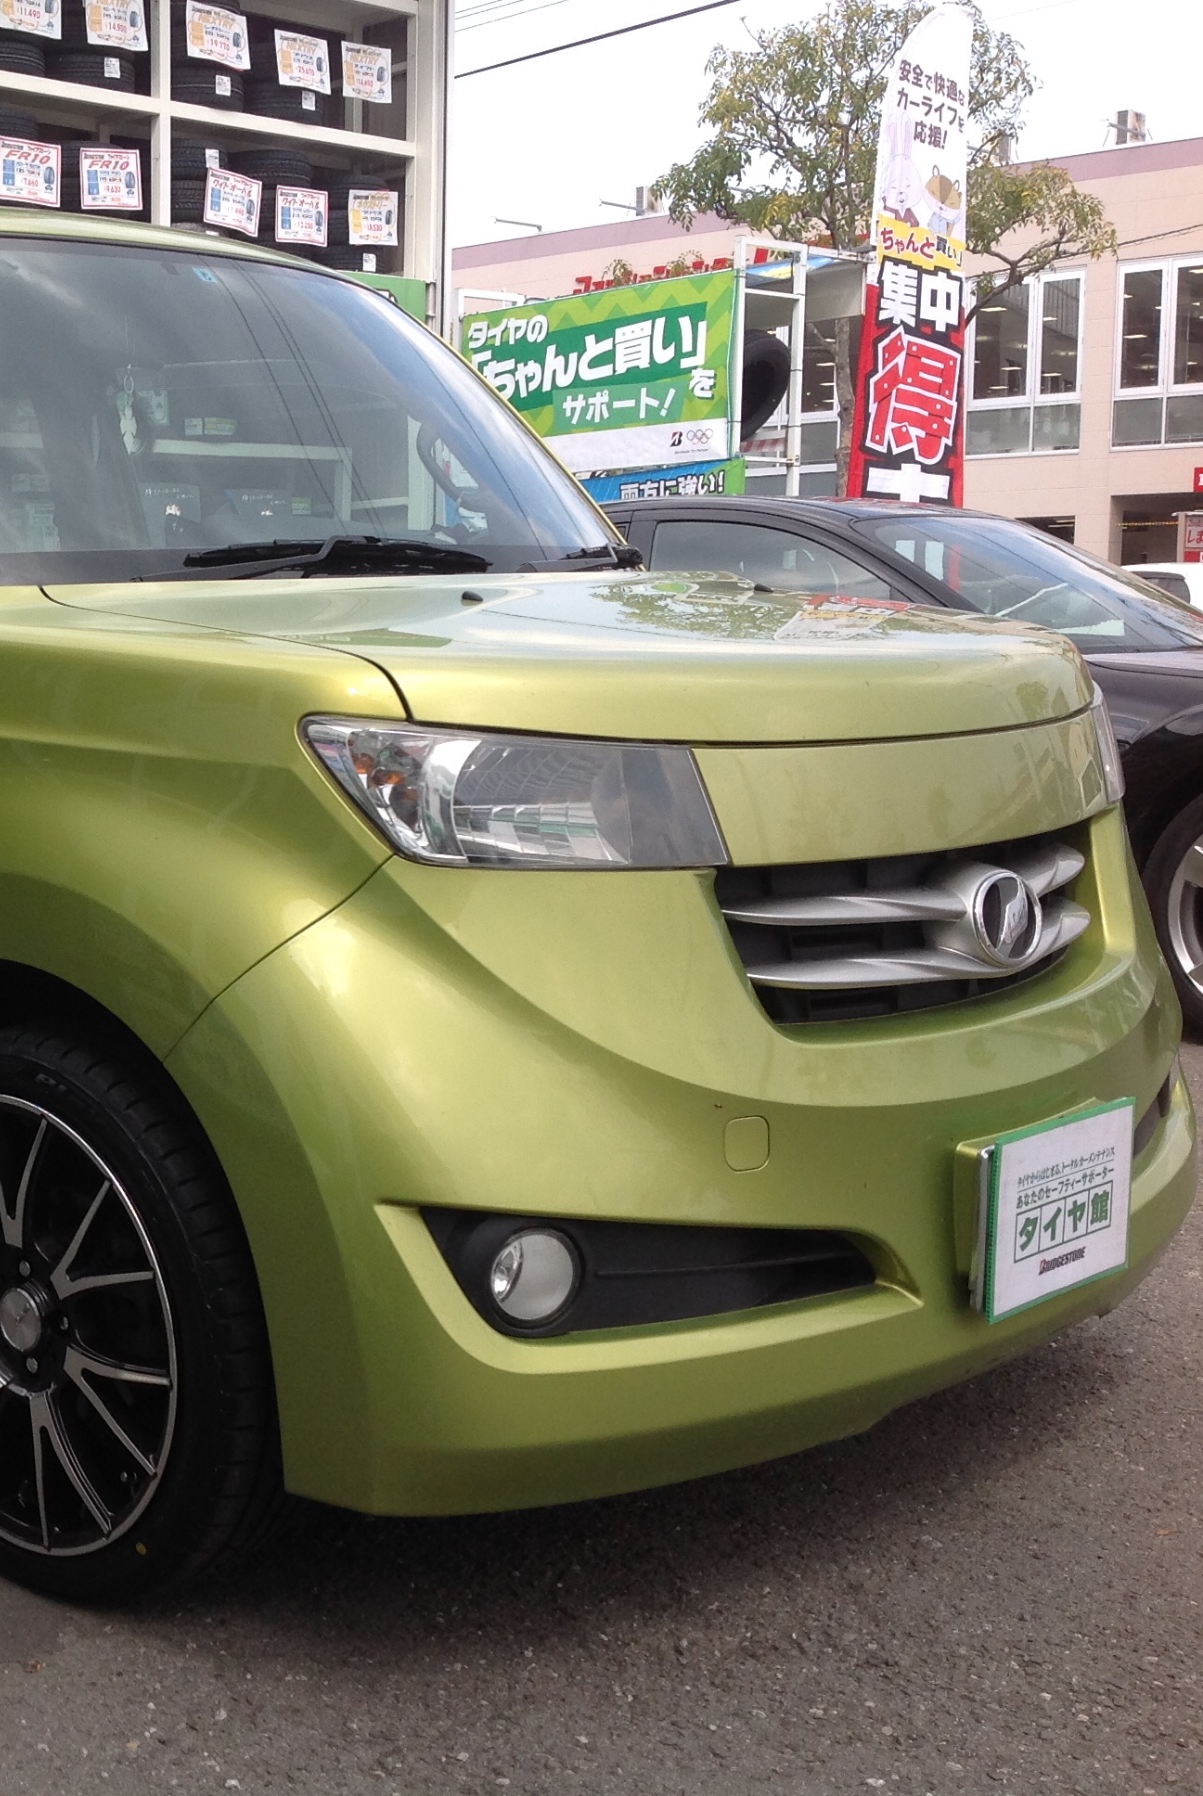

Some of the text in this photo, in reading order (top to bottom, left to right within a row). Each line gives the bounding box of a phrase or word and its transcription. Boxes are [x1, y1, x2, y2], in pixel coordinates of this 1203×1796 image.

[897, 87, 964, 134] カーライフを
[5, 150, 51, 165] FR10
[88, 160, 129, 171] FR10
[878, 261, 961, 332] 集中
[468, 314, 548, 350] タイヤの
[689, 368, 716, 400] を
[561, 387, 676, 425] サポート!
[1018, 1189, 1110, 1252] タイヤ館
[1038, 1246, 1086, 1276] BRIDGESTONE
